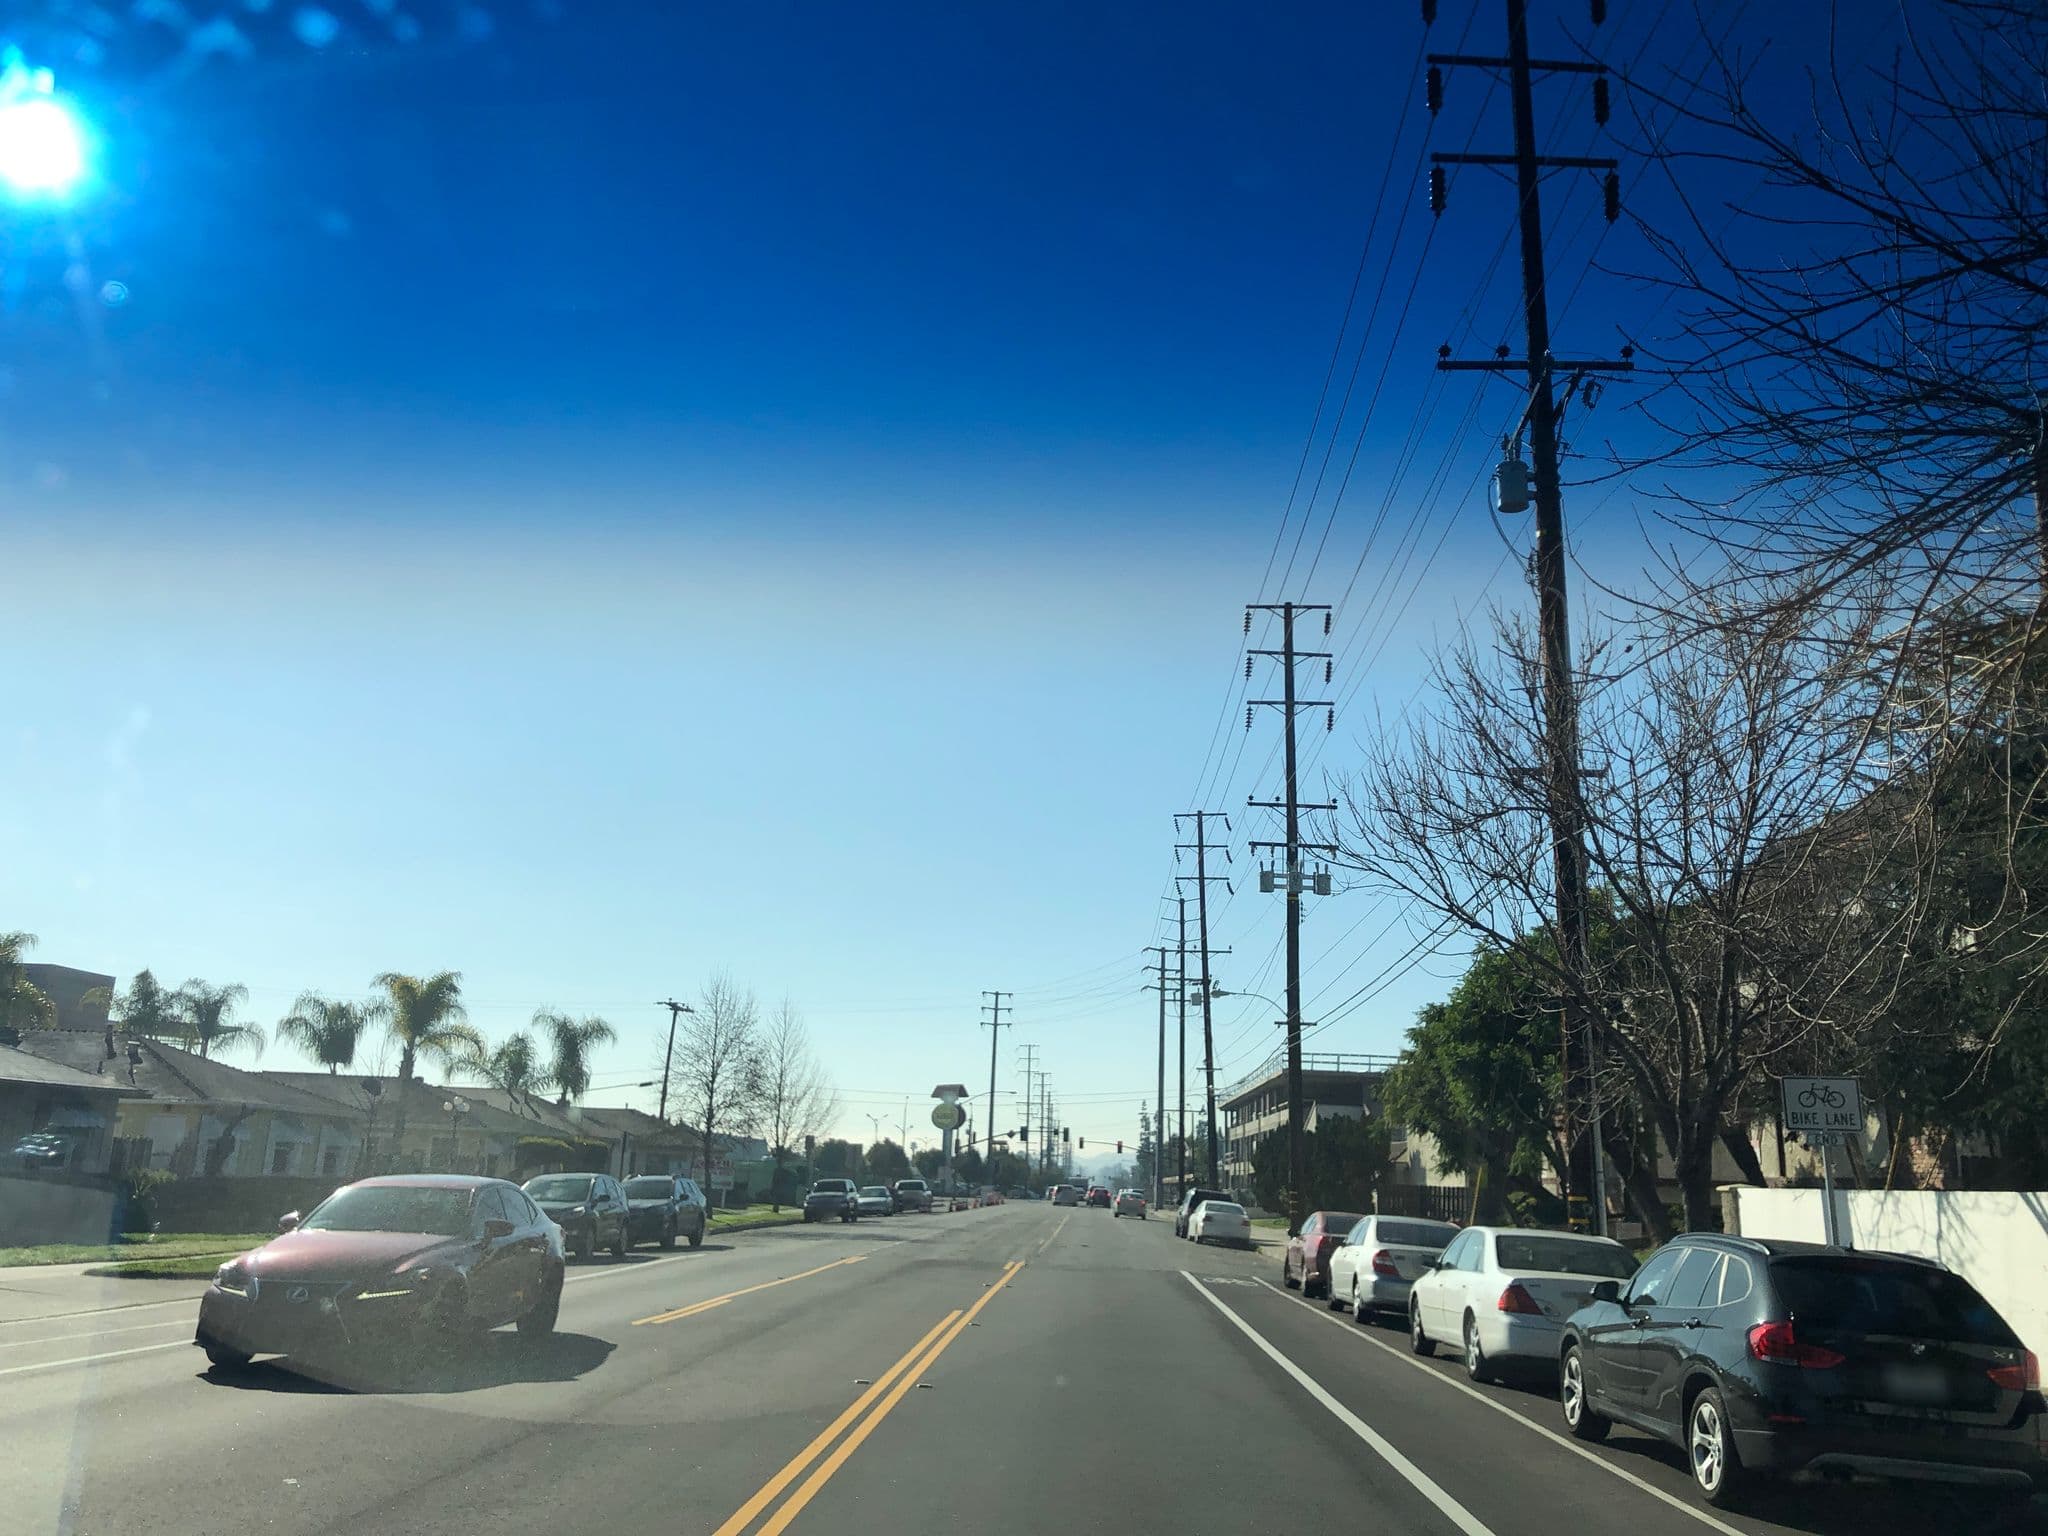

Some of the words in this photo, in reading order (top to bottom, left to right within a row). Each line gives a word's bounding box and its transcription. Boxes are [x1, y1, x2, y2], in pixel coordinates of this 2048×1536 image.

[1791, 1111, 1819, 1125] BIKE
[1825, 1112, 1856, 1126] LANE
[1815, 1134, 1838, 1145] END
